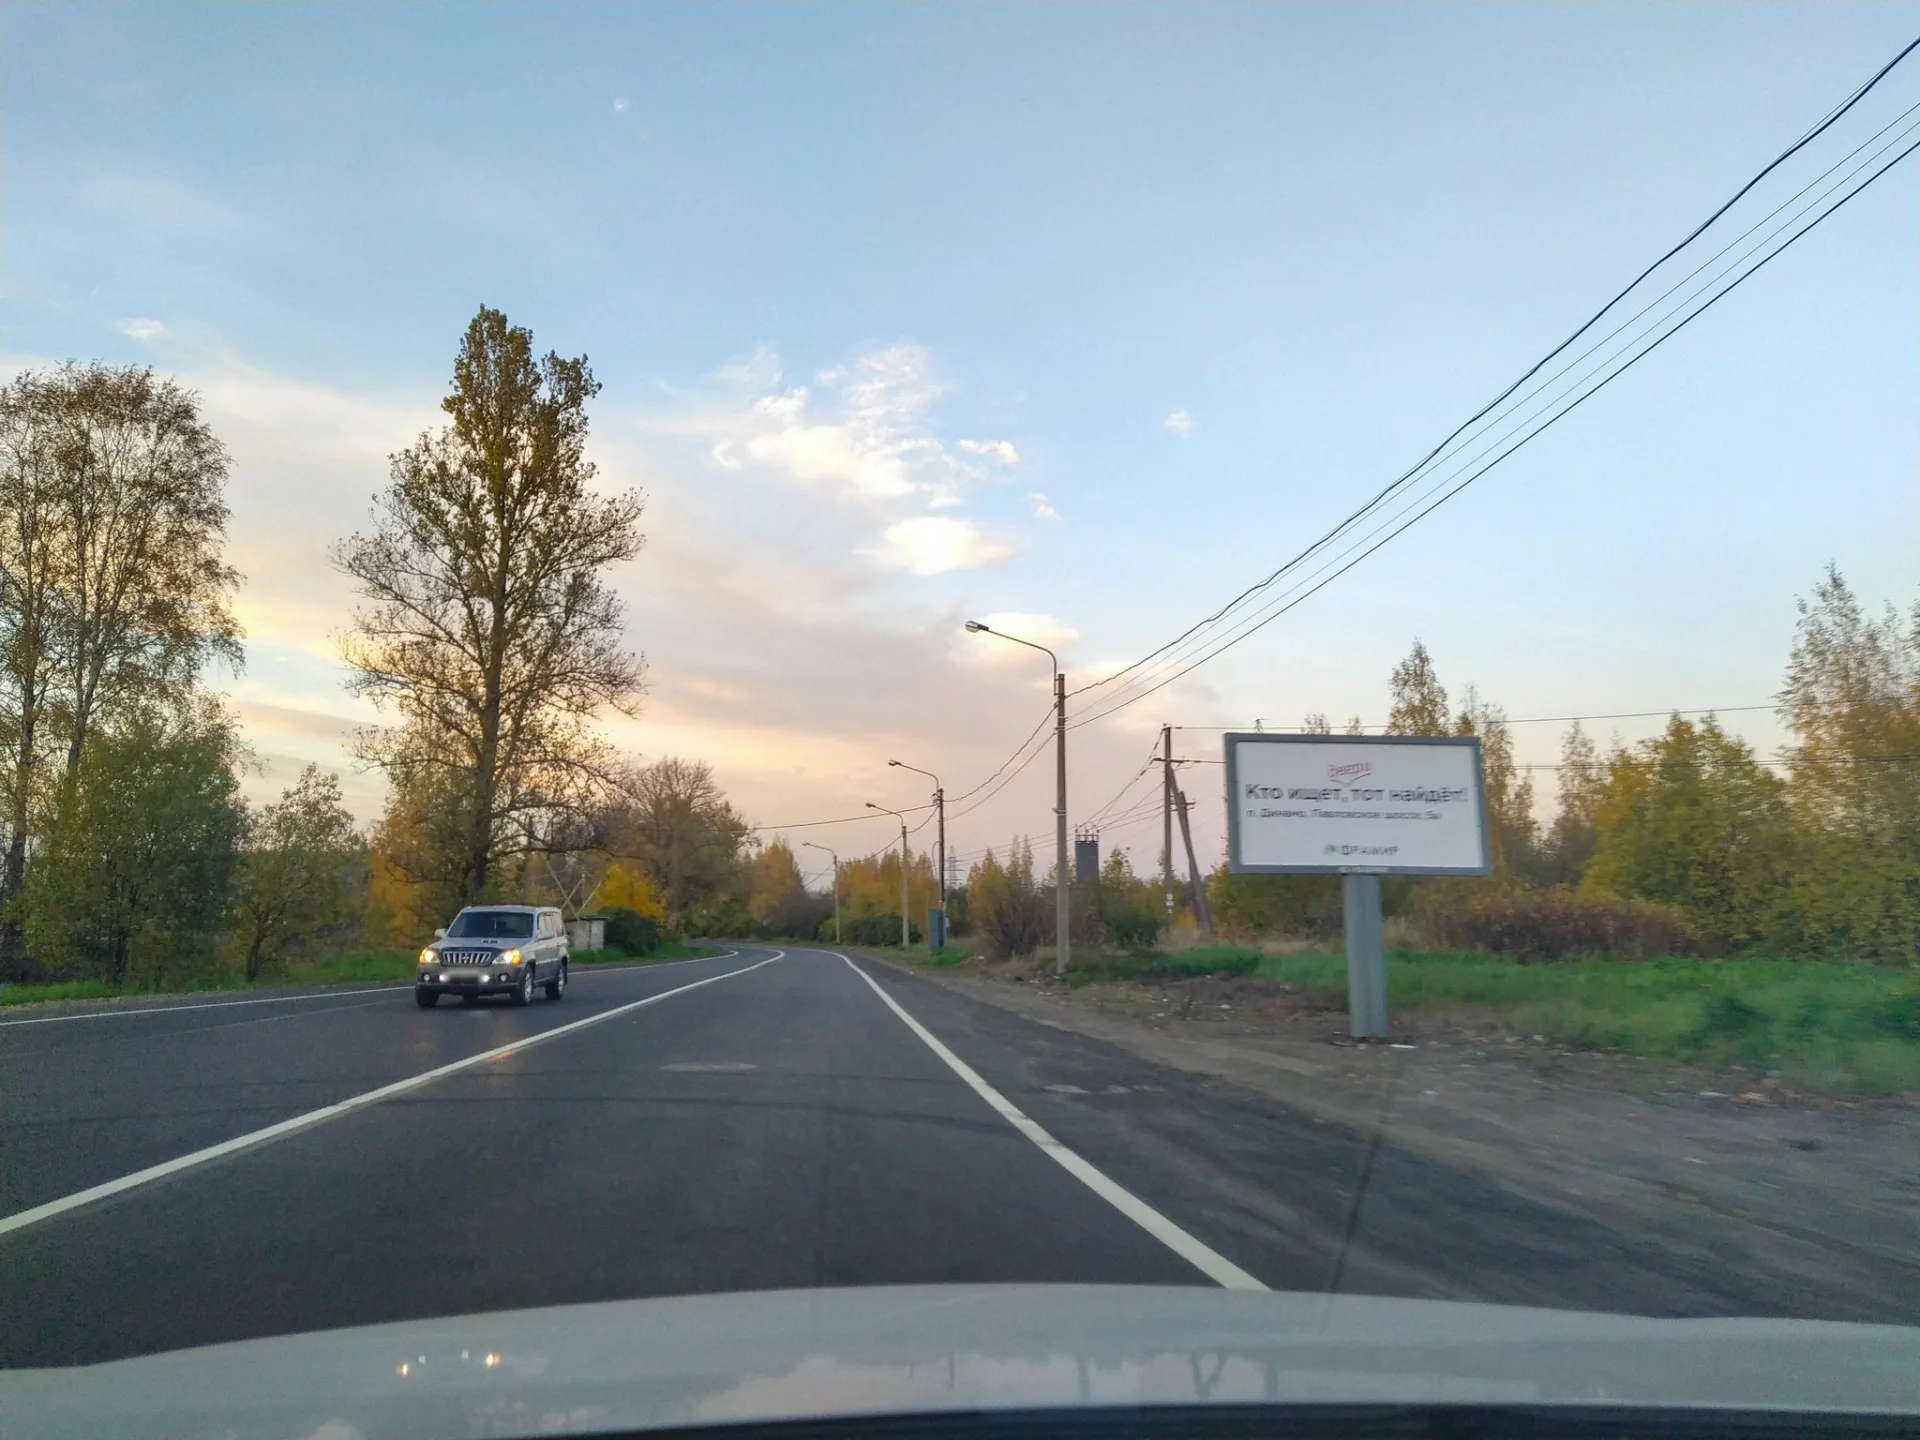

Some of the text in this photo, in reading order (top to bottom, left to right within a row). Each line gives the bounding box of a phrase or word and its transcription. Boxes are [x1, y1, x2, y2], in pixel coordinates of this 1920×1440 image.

[1245, 784, 1468, 804] Кто ищет, тот найдёт!
